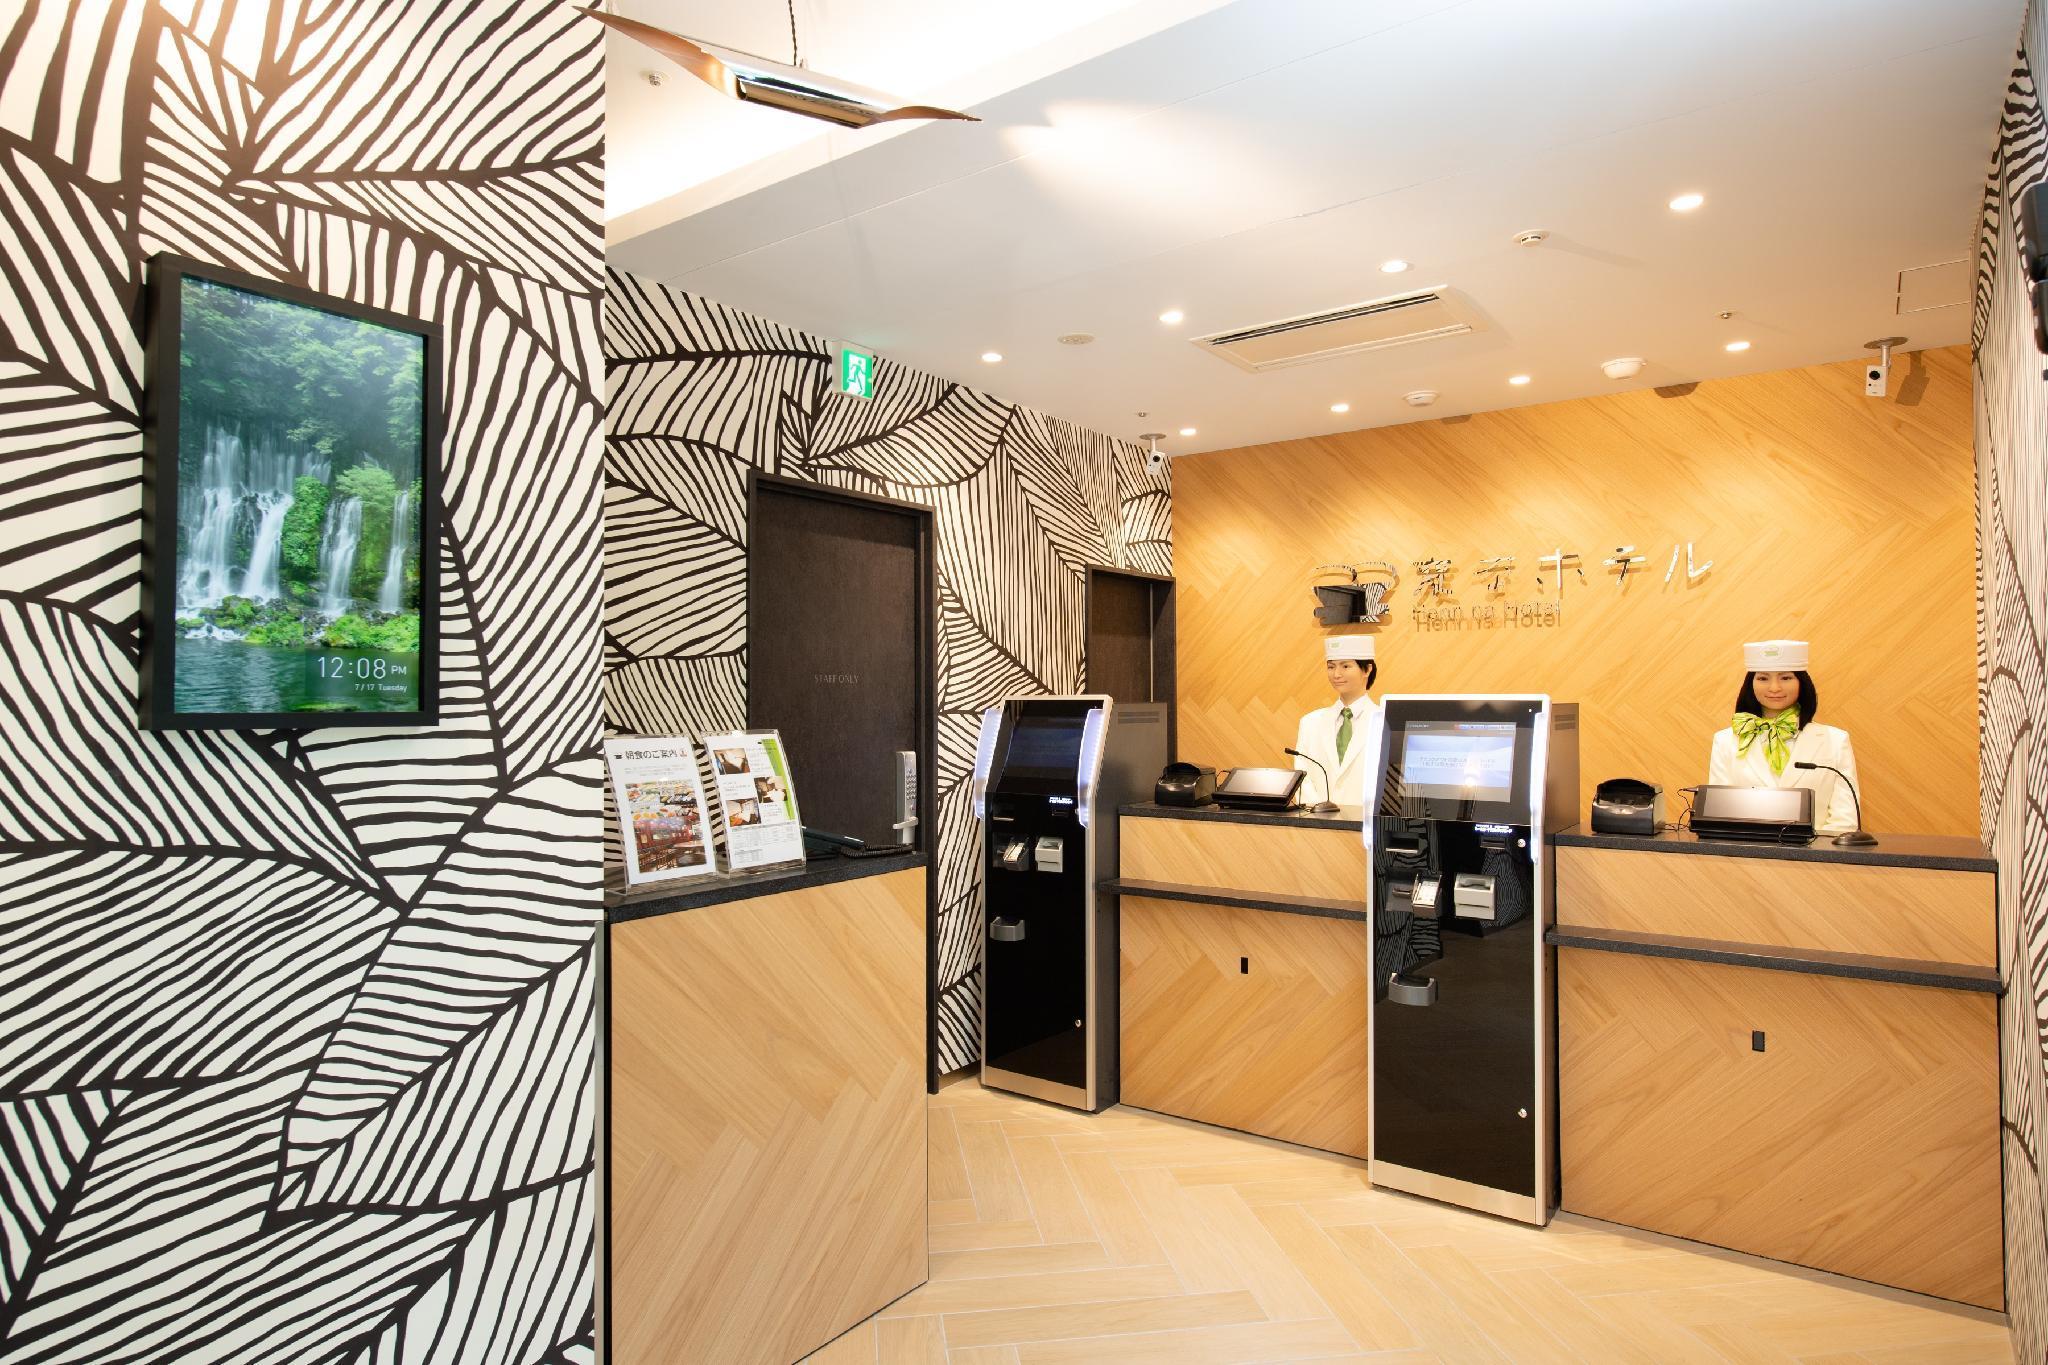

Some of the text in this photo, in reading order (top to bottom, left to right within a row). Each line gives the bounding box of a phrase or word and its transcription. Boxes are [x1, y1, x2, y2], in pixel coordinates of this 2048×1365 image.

[1503, 600, 1561, 628] Hotel
[317, 656, 407, 679] 12:08 PM
[378, 684, 407, 692] Tuesday
